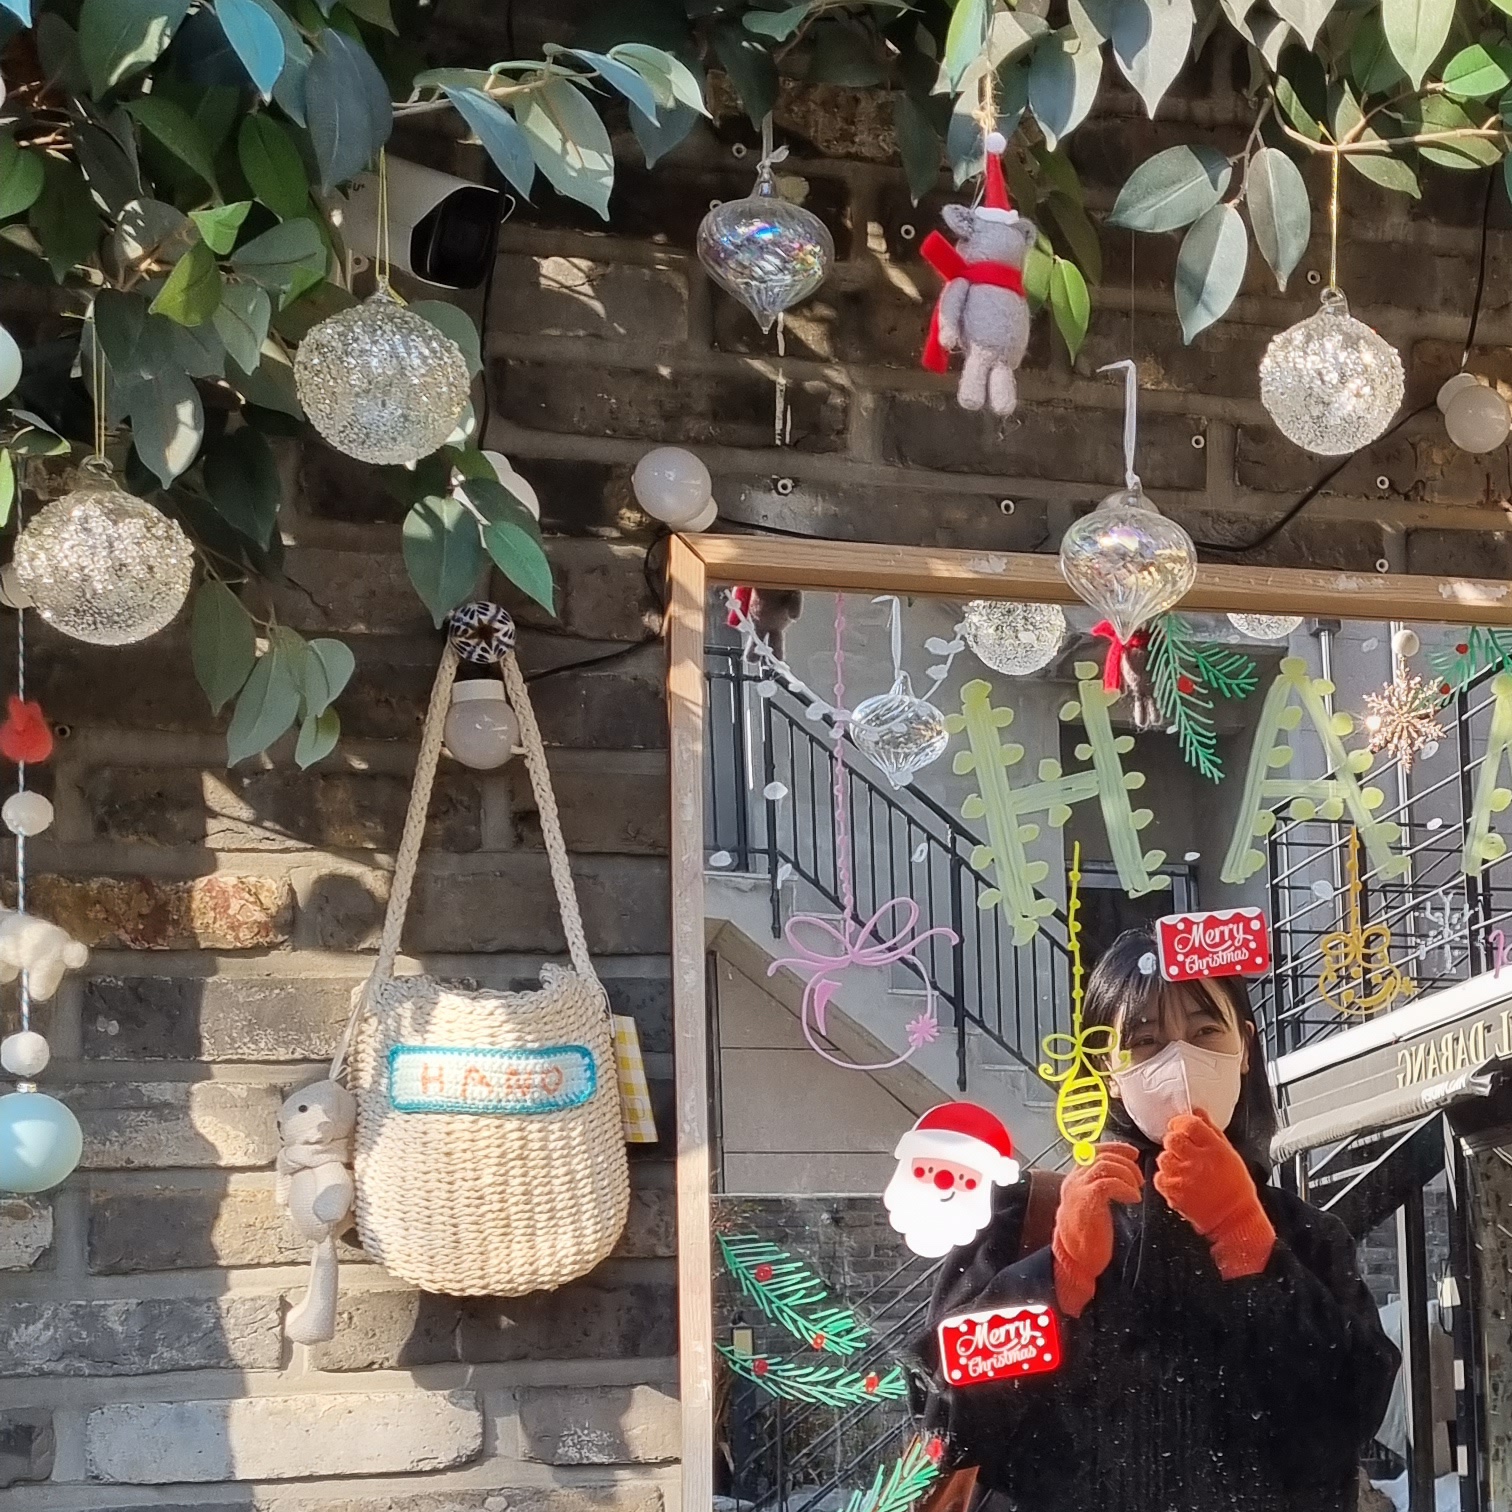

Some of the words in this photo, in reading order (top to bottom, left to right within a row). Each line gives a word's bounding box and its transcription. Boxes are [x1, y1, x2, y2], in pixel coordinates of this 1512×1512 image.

[1174, 922, 1254, 953] Merry
[1185, 946, 1250, 974] Christmas
[421, 1062, 563, 1098] HANO
[956, 1318, 1042, 1356] Merry
[968, 1344, 1038, 1378] Christmas
